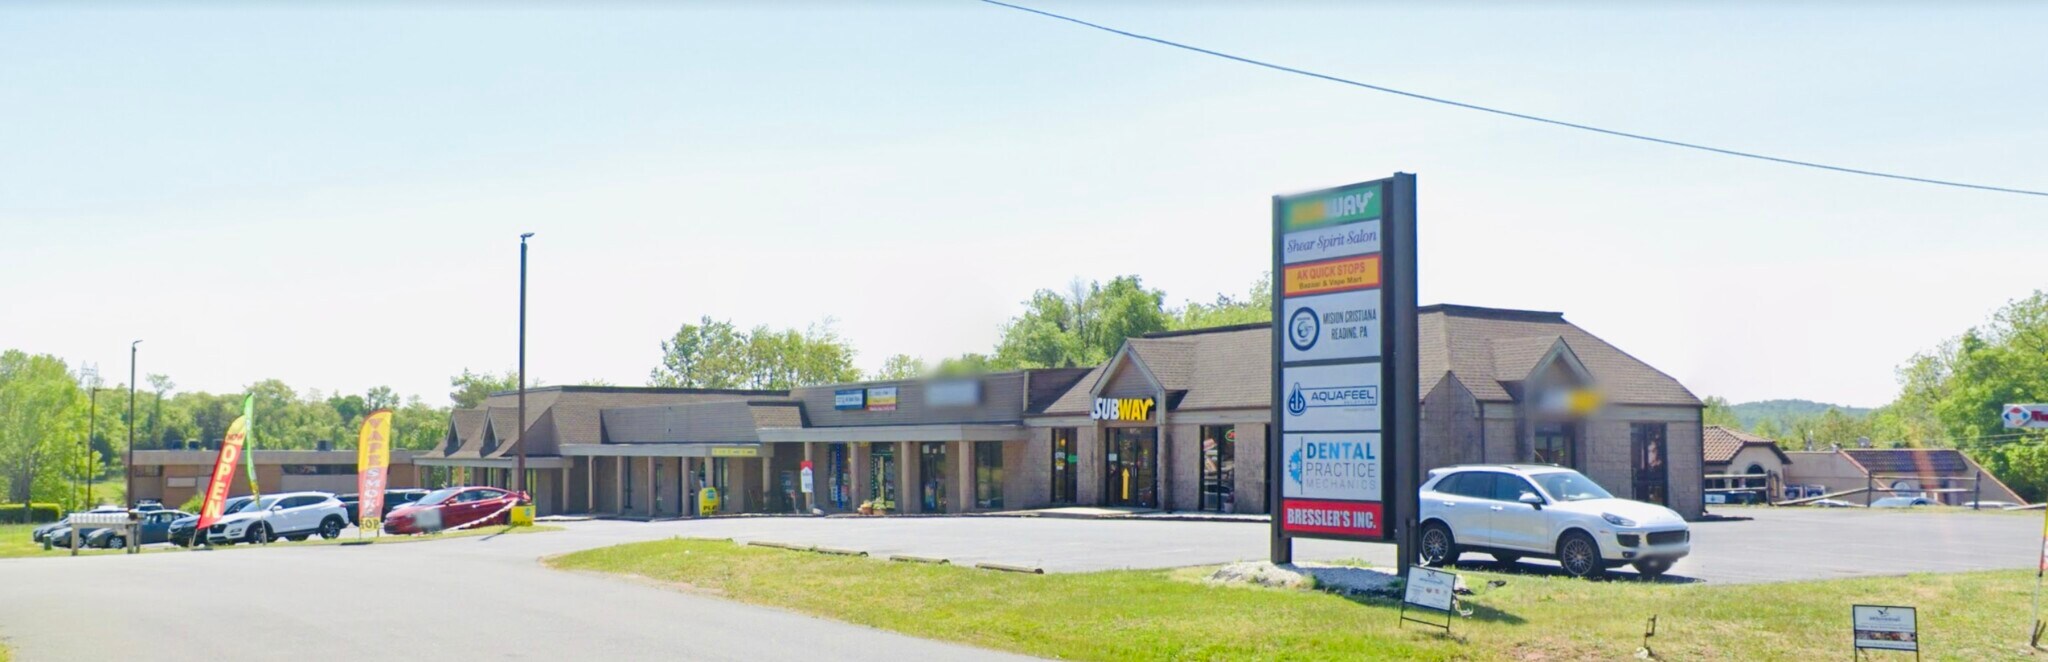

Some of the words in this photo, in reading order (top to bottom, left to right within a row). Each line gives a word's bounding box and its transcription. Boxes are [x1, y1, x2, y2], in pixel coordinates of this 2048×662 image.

[1287, 239, 1316, 253] Shear
[1317, 233, 1345, 252] Spirit
[1347, 229, 1377, 245] Salon
[1297, 269, 1308, 280] AK
[1310, 265, 1336, 279] QUICK
[1337, 261, 1365, 276] STOPS
[1329, 278, 1346, 286] Vape
[1347, 276, 1362, 284] Mart
[1323, 312, 1344, 324] MISION
[1345, 308, 1377, 323] CRISTIANA
[1360, 325, 1368, 338] PA
[1311, 389, 1375, 402] AQUAFEEL
[1091, 397, 1155, 421] SUBWAY
[368, 417, 385, 467] VAPE
[1306, 442, 1376, 460] DENTAL
[1306, 462, 1376, 478] PRACTICE
[206, 444, 237, 518] OPEN
[1306, 478, 1377, 490] MECHANICS
[1287, 508, 1351, 527] BRESSLER'S
[1353, 511, 1377, 529] INC.
